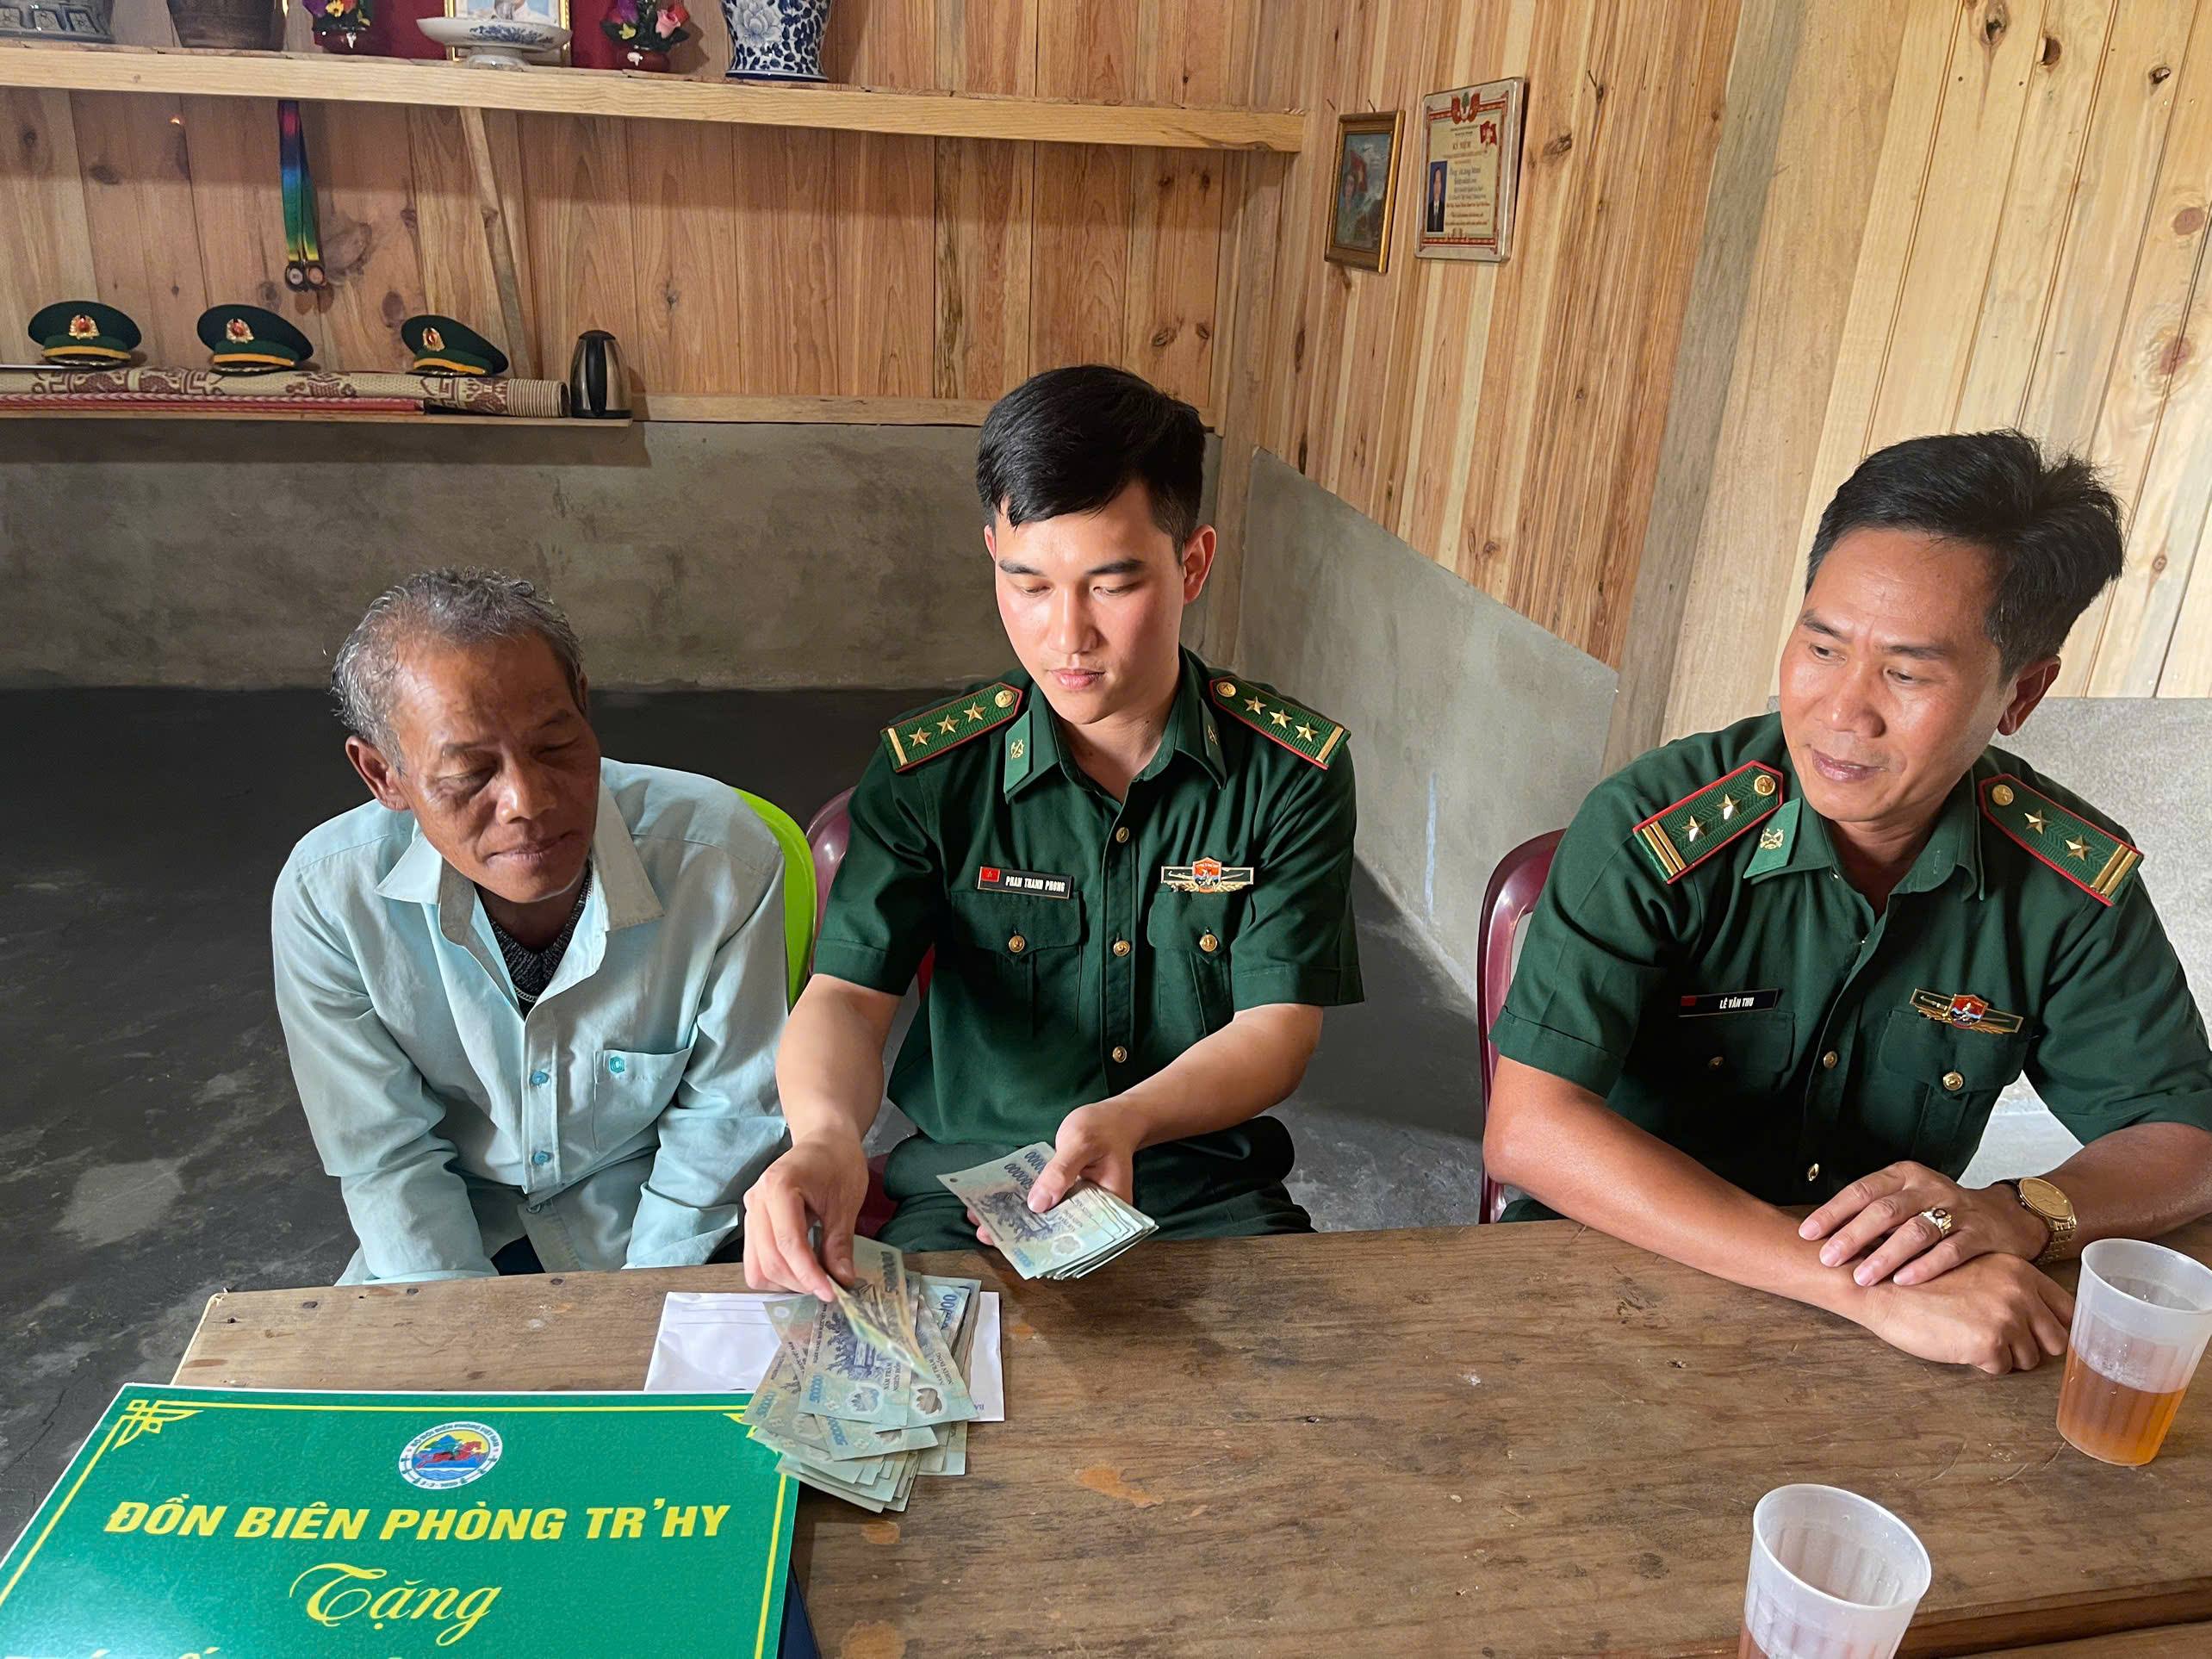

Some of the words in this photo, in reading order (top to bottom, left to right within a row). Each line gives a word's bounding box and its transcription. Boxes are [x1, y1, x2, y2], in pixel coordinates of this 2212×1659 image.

[1045, 879, 1066, 892] PHONG
[1719, 997, 1728, 1009] LÊ
[1728, 996, 1742, 1009] VĂN
[103, 1494, 227, 1537] ĐỒN
[233, 1501, 370, 1539] BIÊN
[378, 1501, 568, 1540] PHÒNG
[289, 1563, 502, 1646] Tặng
